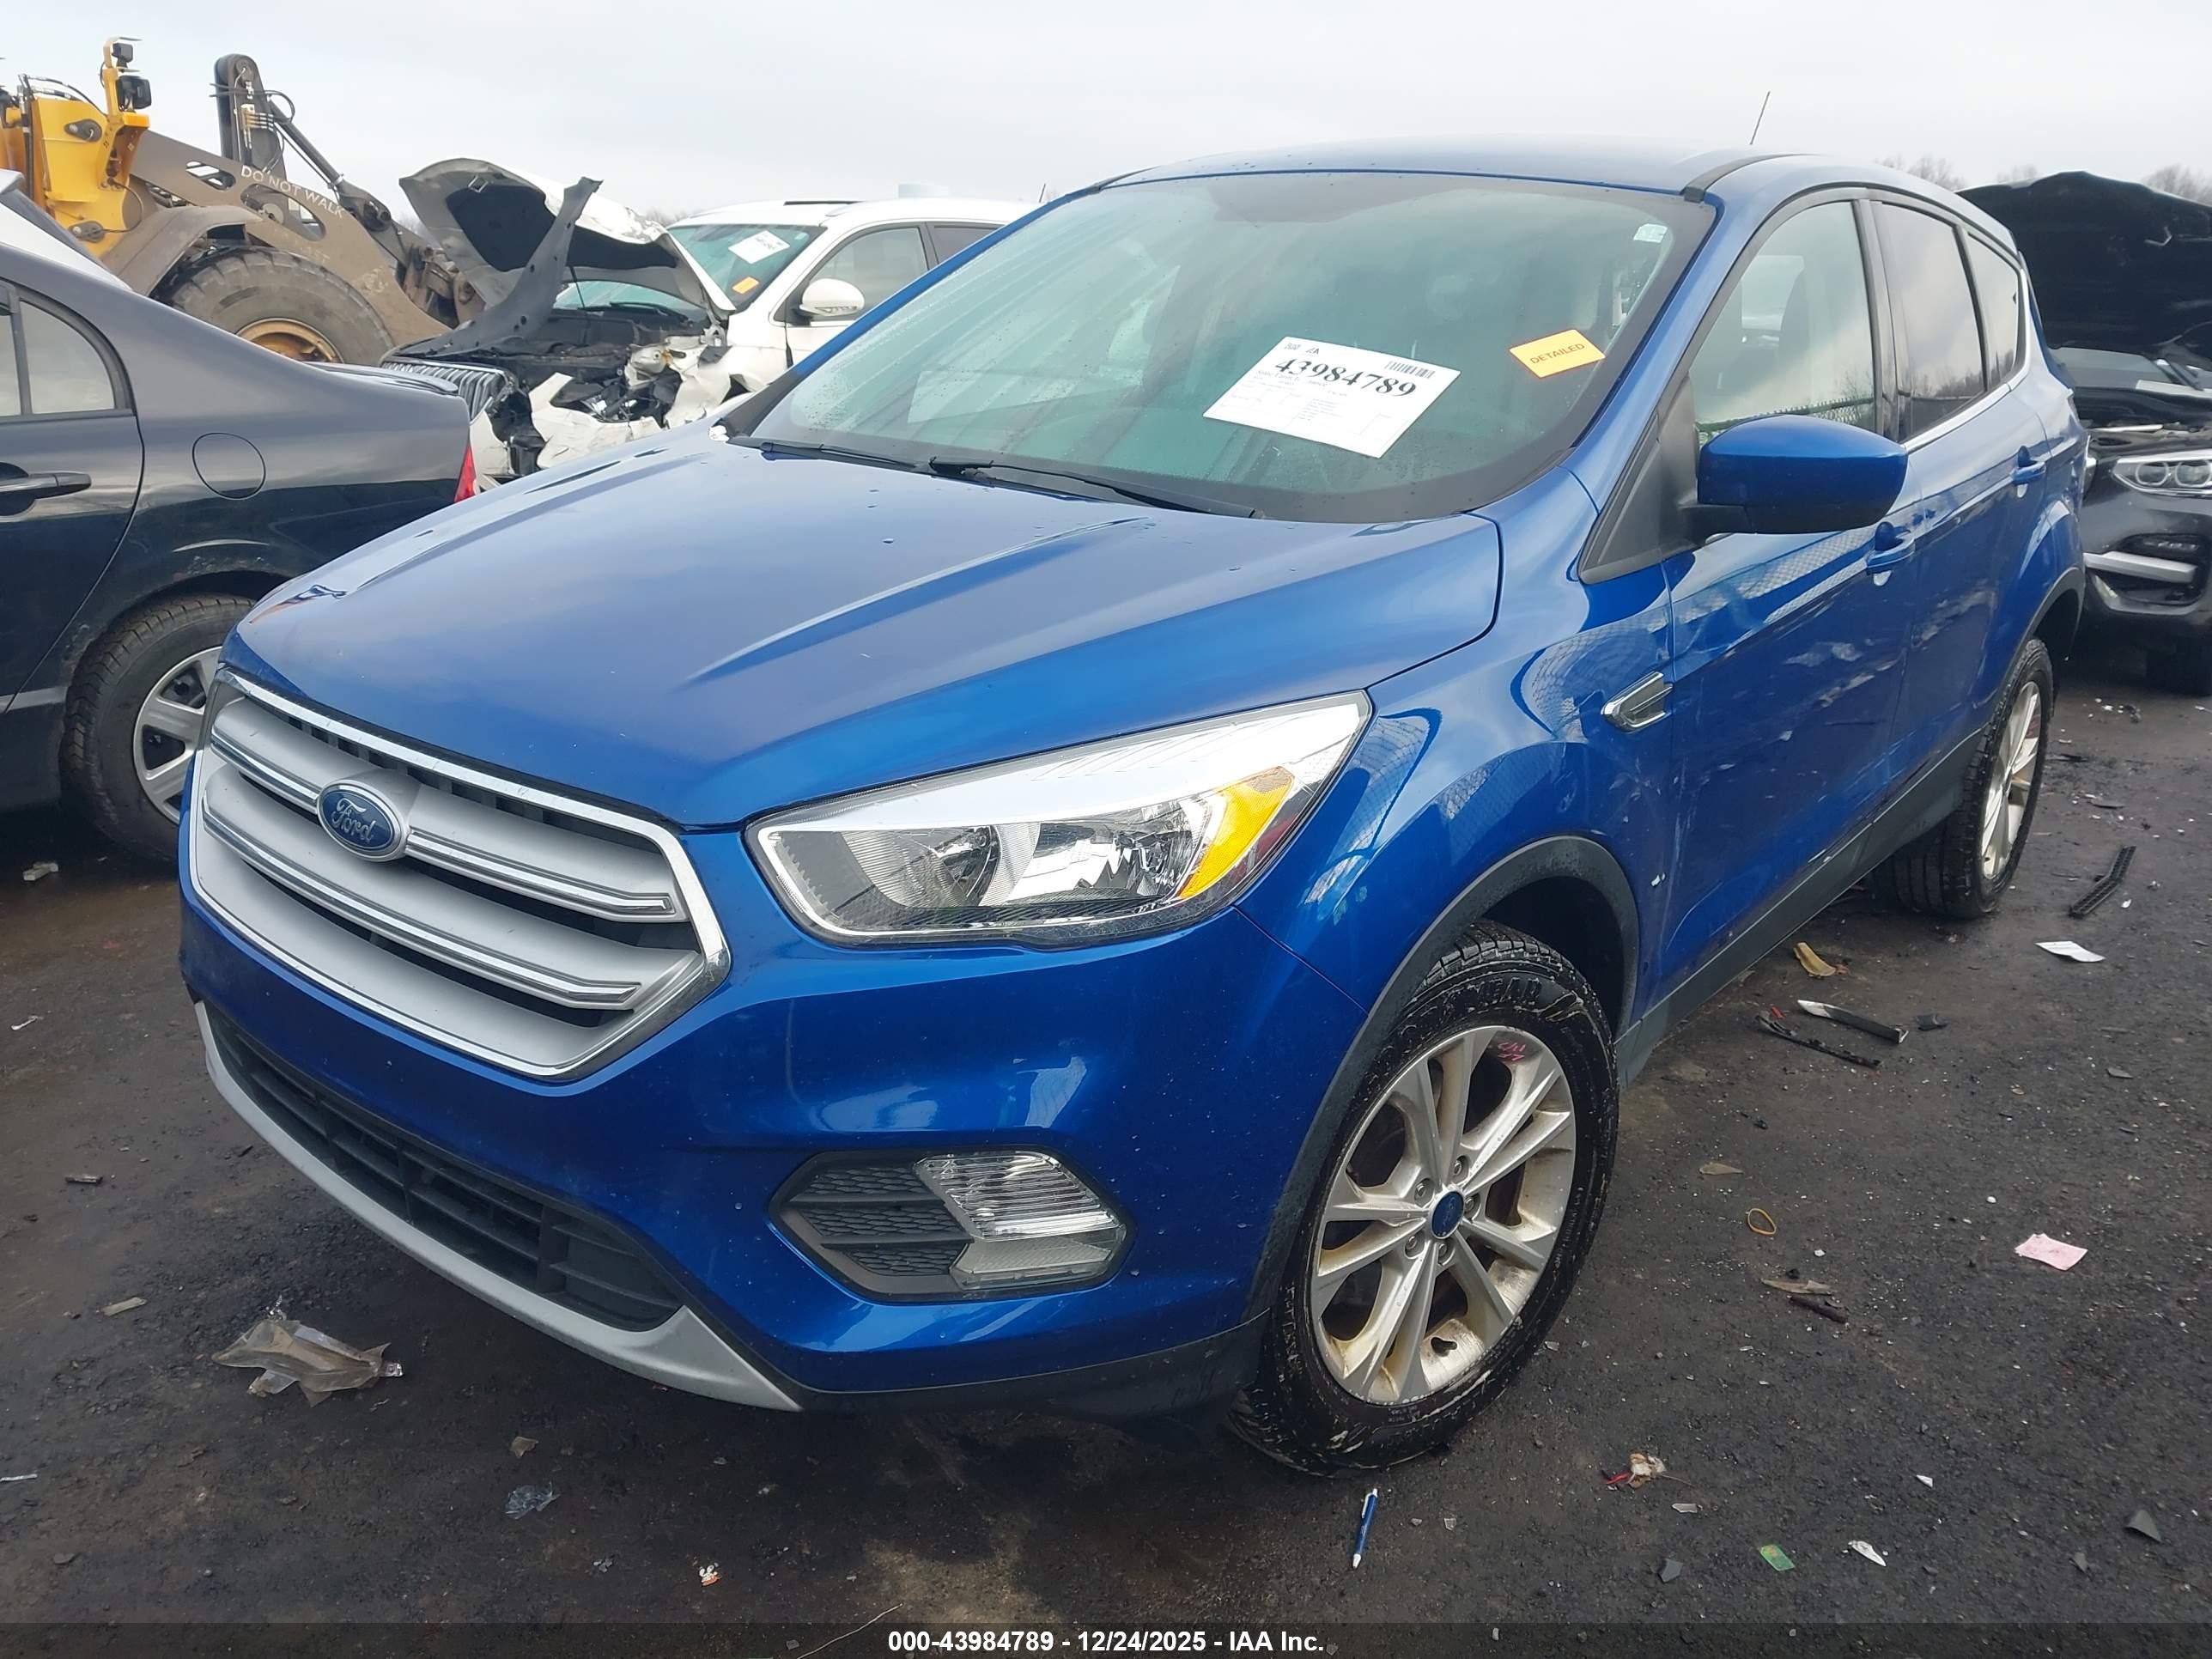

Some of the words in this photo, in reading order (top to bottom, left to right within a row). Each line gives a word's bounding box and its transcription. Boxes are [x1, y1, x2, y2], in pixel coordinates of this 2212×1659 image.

[240, 164, 264, 182] DO
[268, 175, 301, 197] NOT
[305, 189, 344, 219] WALK
[1529, 343, 1585, 364] DETAILED
[1274, 357, 1417, 397] 43984789
[331, 798, 376, 842] Ford
